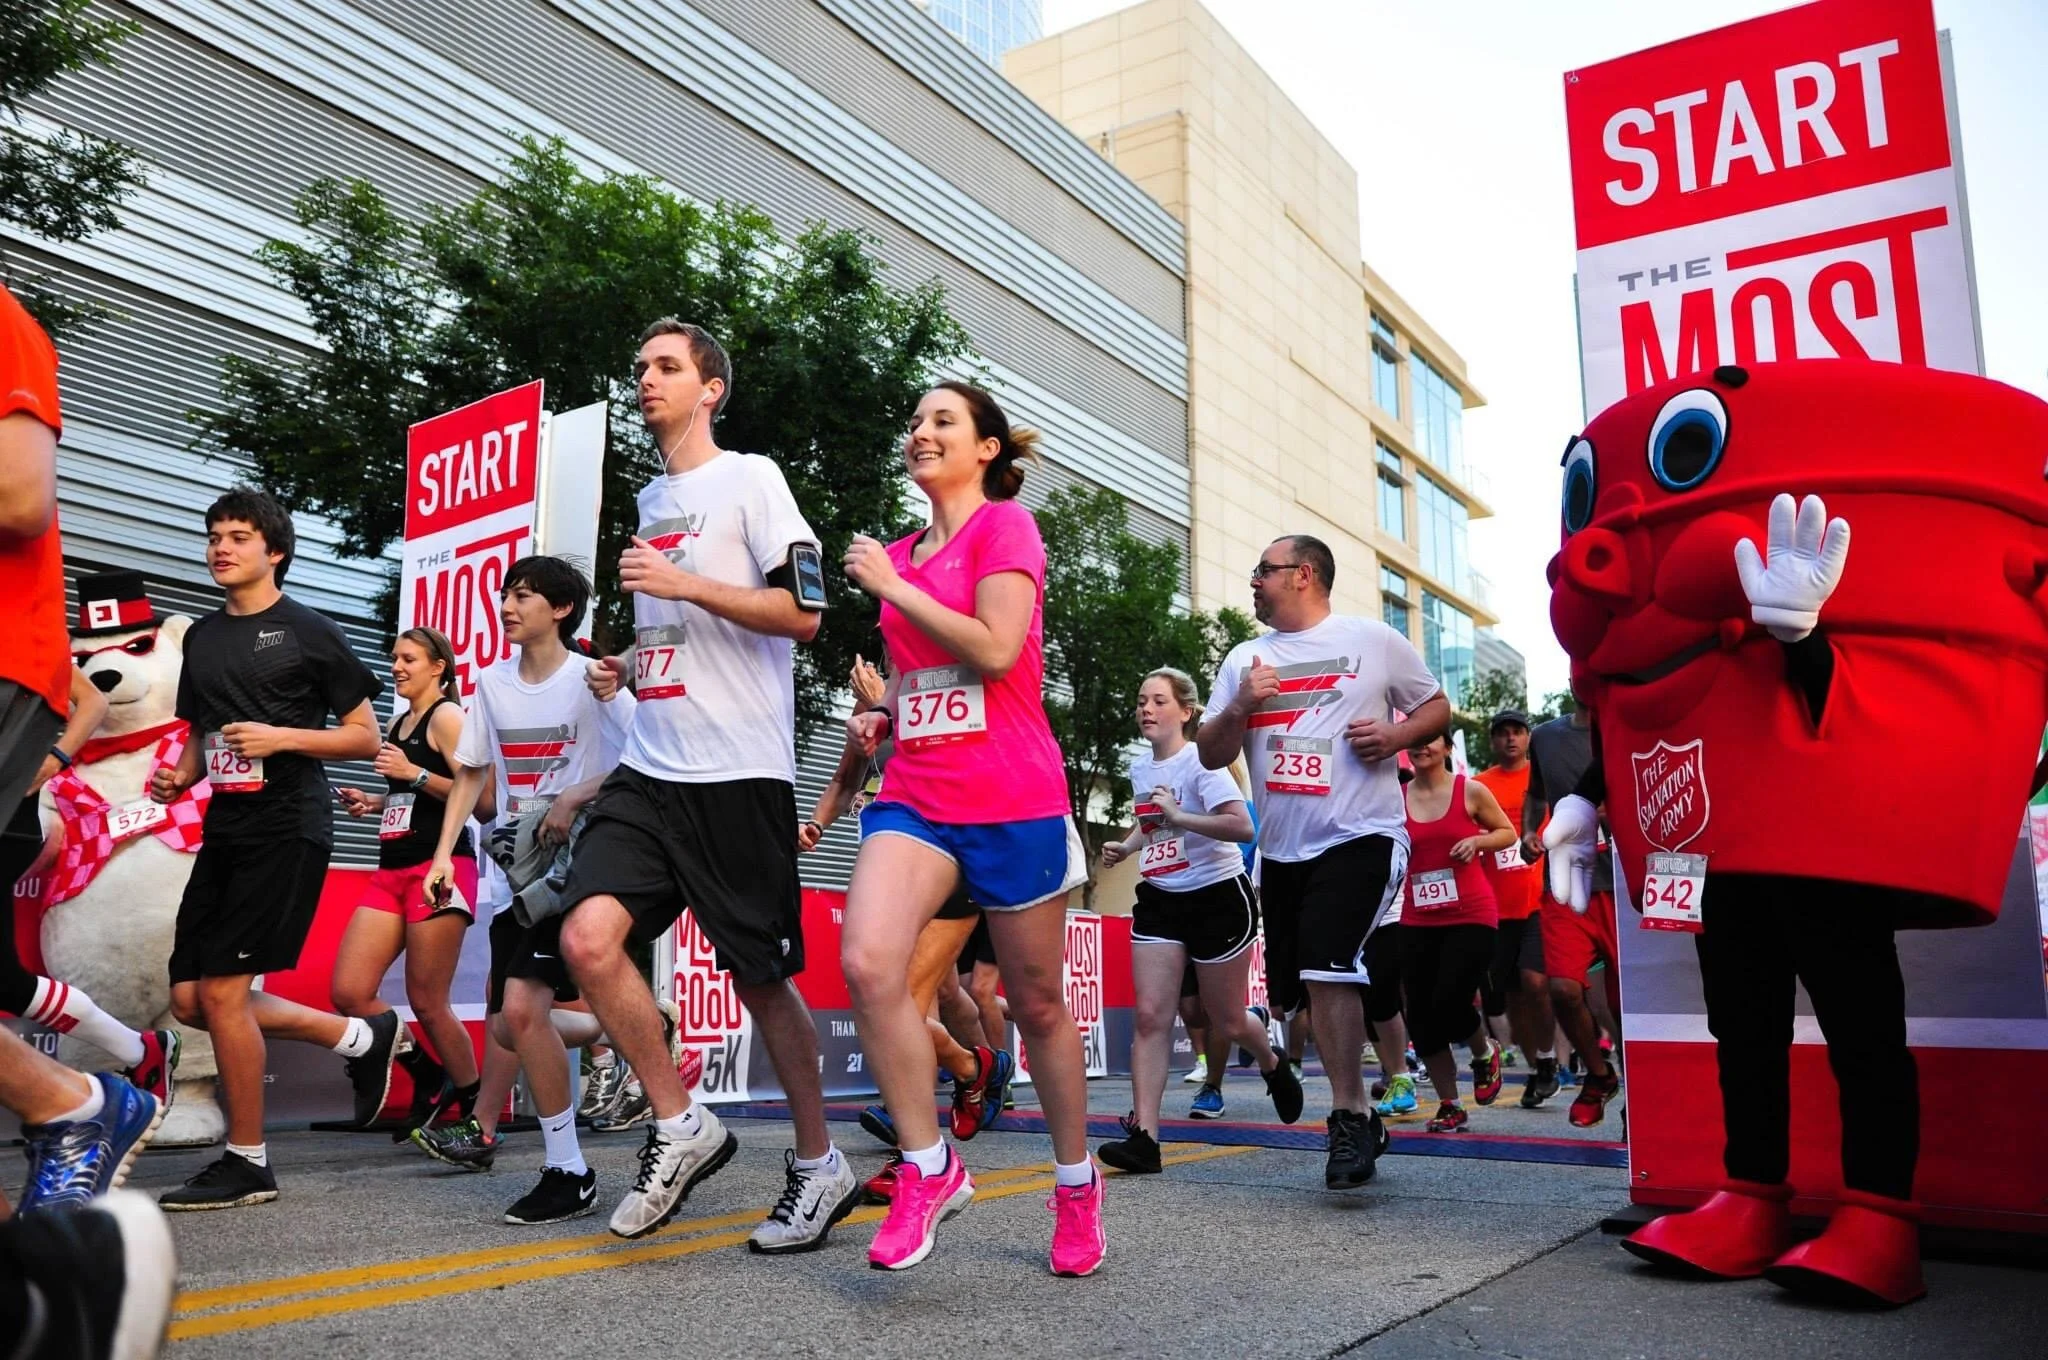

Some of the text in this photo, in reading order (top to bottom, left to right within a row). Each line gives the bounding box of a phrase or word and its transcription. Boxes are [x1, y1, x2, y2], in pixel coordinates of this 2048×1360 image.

[1602, 38, 1900, 207] START
[1617, 256, 1712, 293] THE
[1620, 205, 1949, 396] MOST
[417, 420, 528, 517] START
[416, 550, 451, 570] THE
[413, 525, 530, 669] MOST
[255, 630, 285, 651] RUN
[637, 647, 675, 680] 377
[907, 689, 969, 727] 376
[1272, 754, 1322, 778] 238
[1642, 752, 1668, 792] THE
[1640, 753, 1695, 831] SALVATION
[118, 807, 157, 830] 572
[383, 807, 406, 826] 487
[1660, 786, 1694, 841] ARMY
[1144, 840, 1177, 865] 235
[1418, 882, 1449, 900] 491
[1645, 877, 1694, 911] 642
[673, 969, 743, 1041] GOOD
[831, 1020, 858, 1038] THAN
[702, 1034, 743, 1094] 5K
[846, 1053, 863, 1073] 21
[1082, 1026, 1102, 1070] 5K
